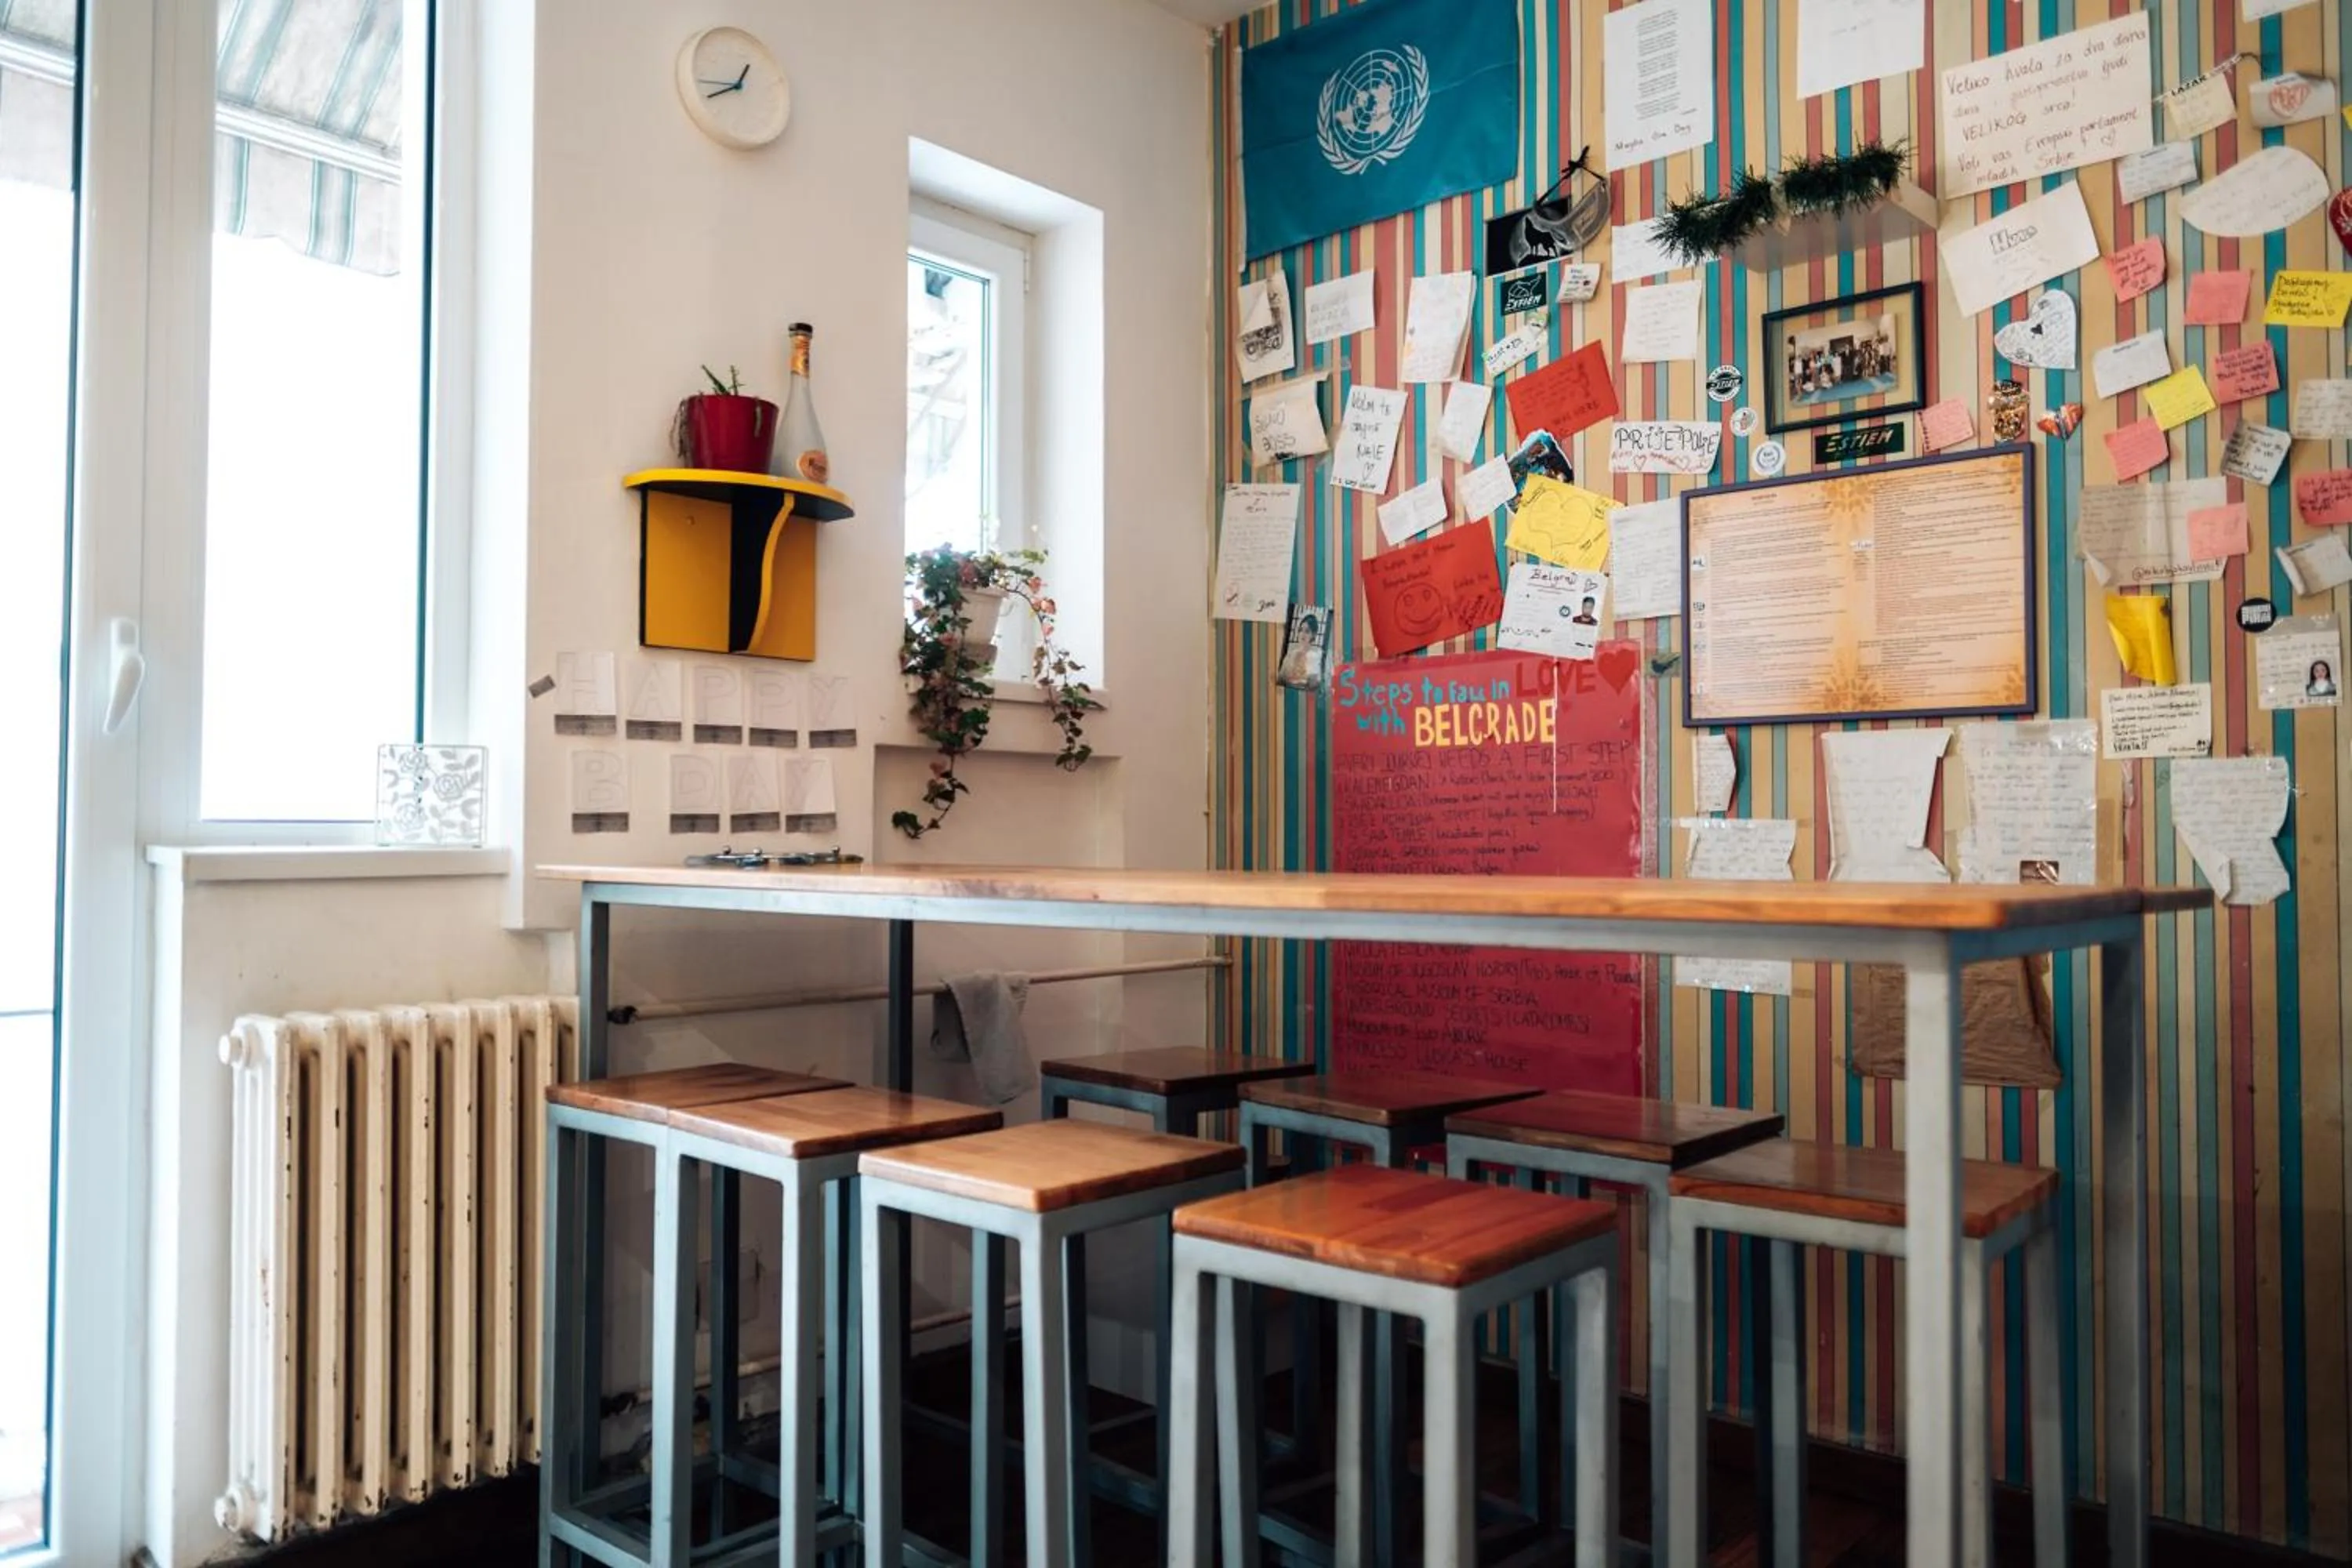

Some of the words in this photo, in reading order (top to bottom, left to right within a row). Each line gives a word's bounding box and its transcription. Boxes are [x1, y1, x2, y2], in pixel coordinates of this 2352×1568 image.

[2005, 60, 2044, 81] hvala
[1962, 113, 2028, 143] VELIKOG
[1339, 666, 1414, 710] Steps
[1421, 676, 1444, 705] to
[1515, 659, 1596, 699] LOVE
[1355, 706, 1407, 735] with
[1414, 698, 1555, 748] BELGRADE
[1587, 740, 1632, 764] STEP
